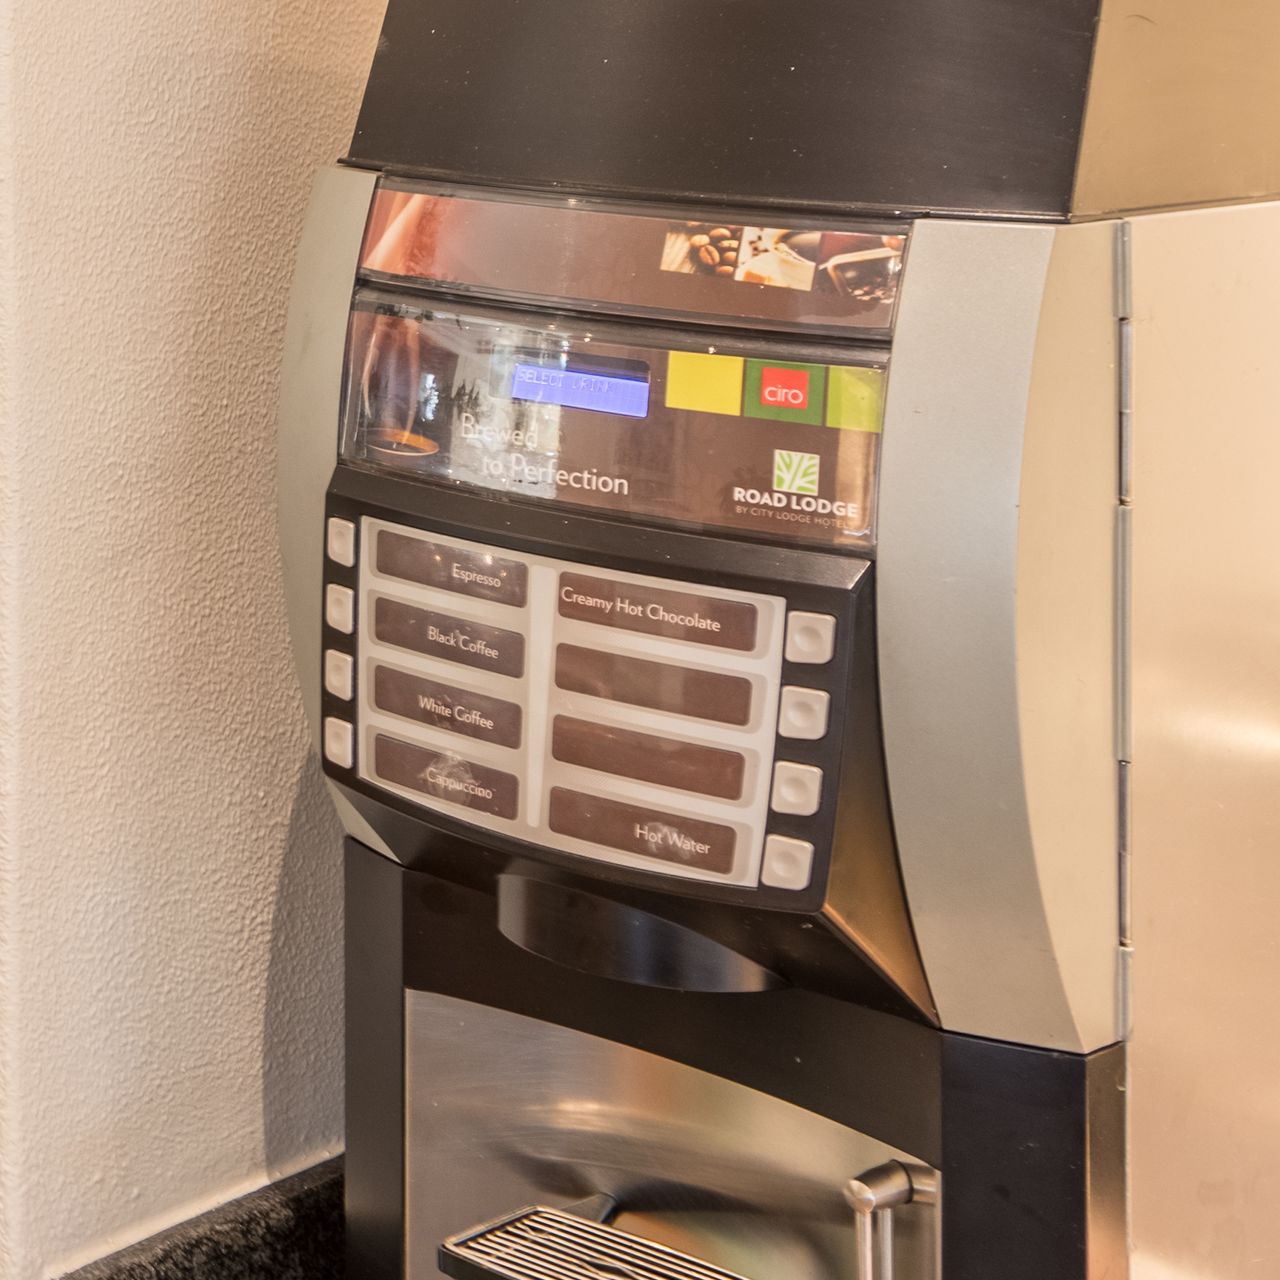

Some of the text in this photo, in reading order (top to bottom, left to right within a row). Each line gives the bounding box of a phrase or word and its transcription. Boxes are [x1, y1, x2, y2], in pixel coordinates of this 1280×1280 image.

[764, 384, 804, 404] ciro
[461, 412, 540, 449] Brewed
[481, 453, 630, 496] to Perfection
[732, 486, 859, 518] ROAD LODGE
[735, 505, 749, 515] BY
[750, 507, 774, 519] CITY
[776, 511, 812, 525] LODGE
[451, 562, 502, 588] Espresso
[560, 586, 721, 633] Creamy Hot Chocolate
[426, 625, 499, 660] Black Coffee
[418, 694, 495, 730] White Coffee
[425, 767, 493, 800] Cappuccino
[634, 823, 712, 855] Hot Water
